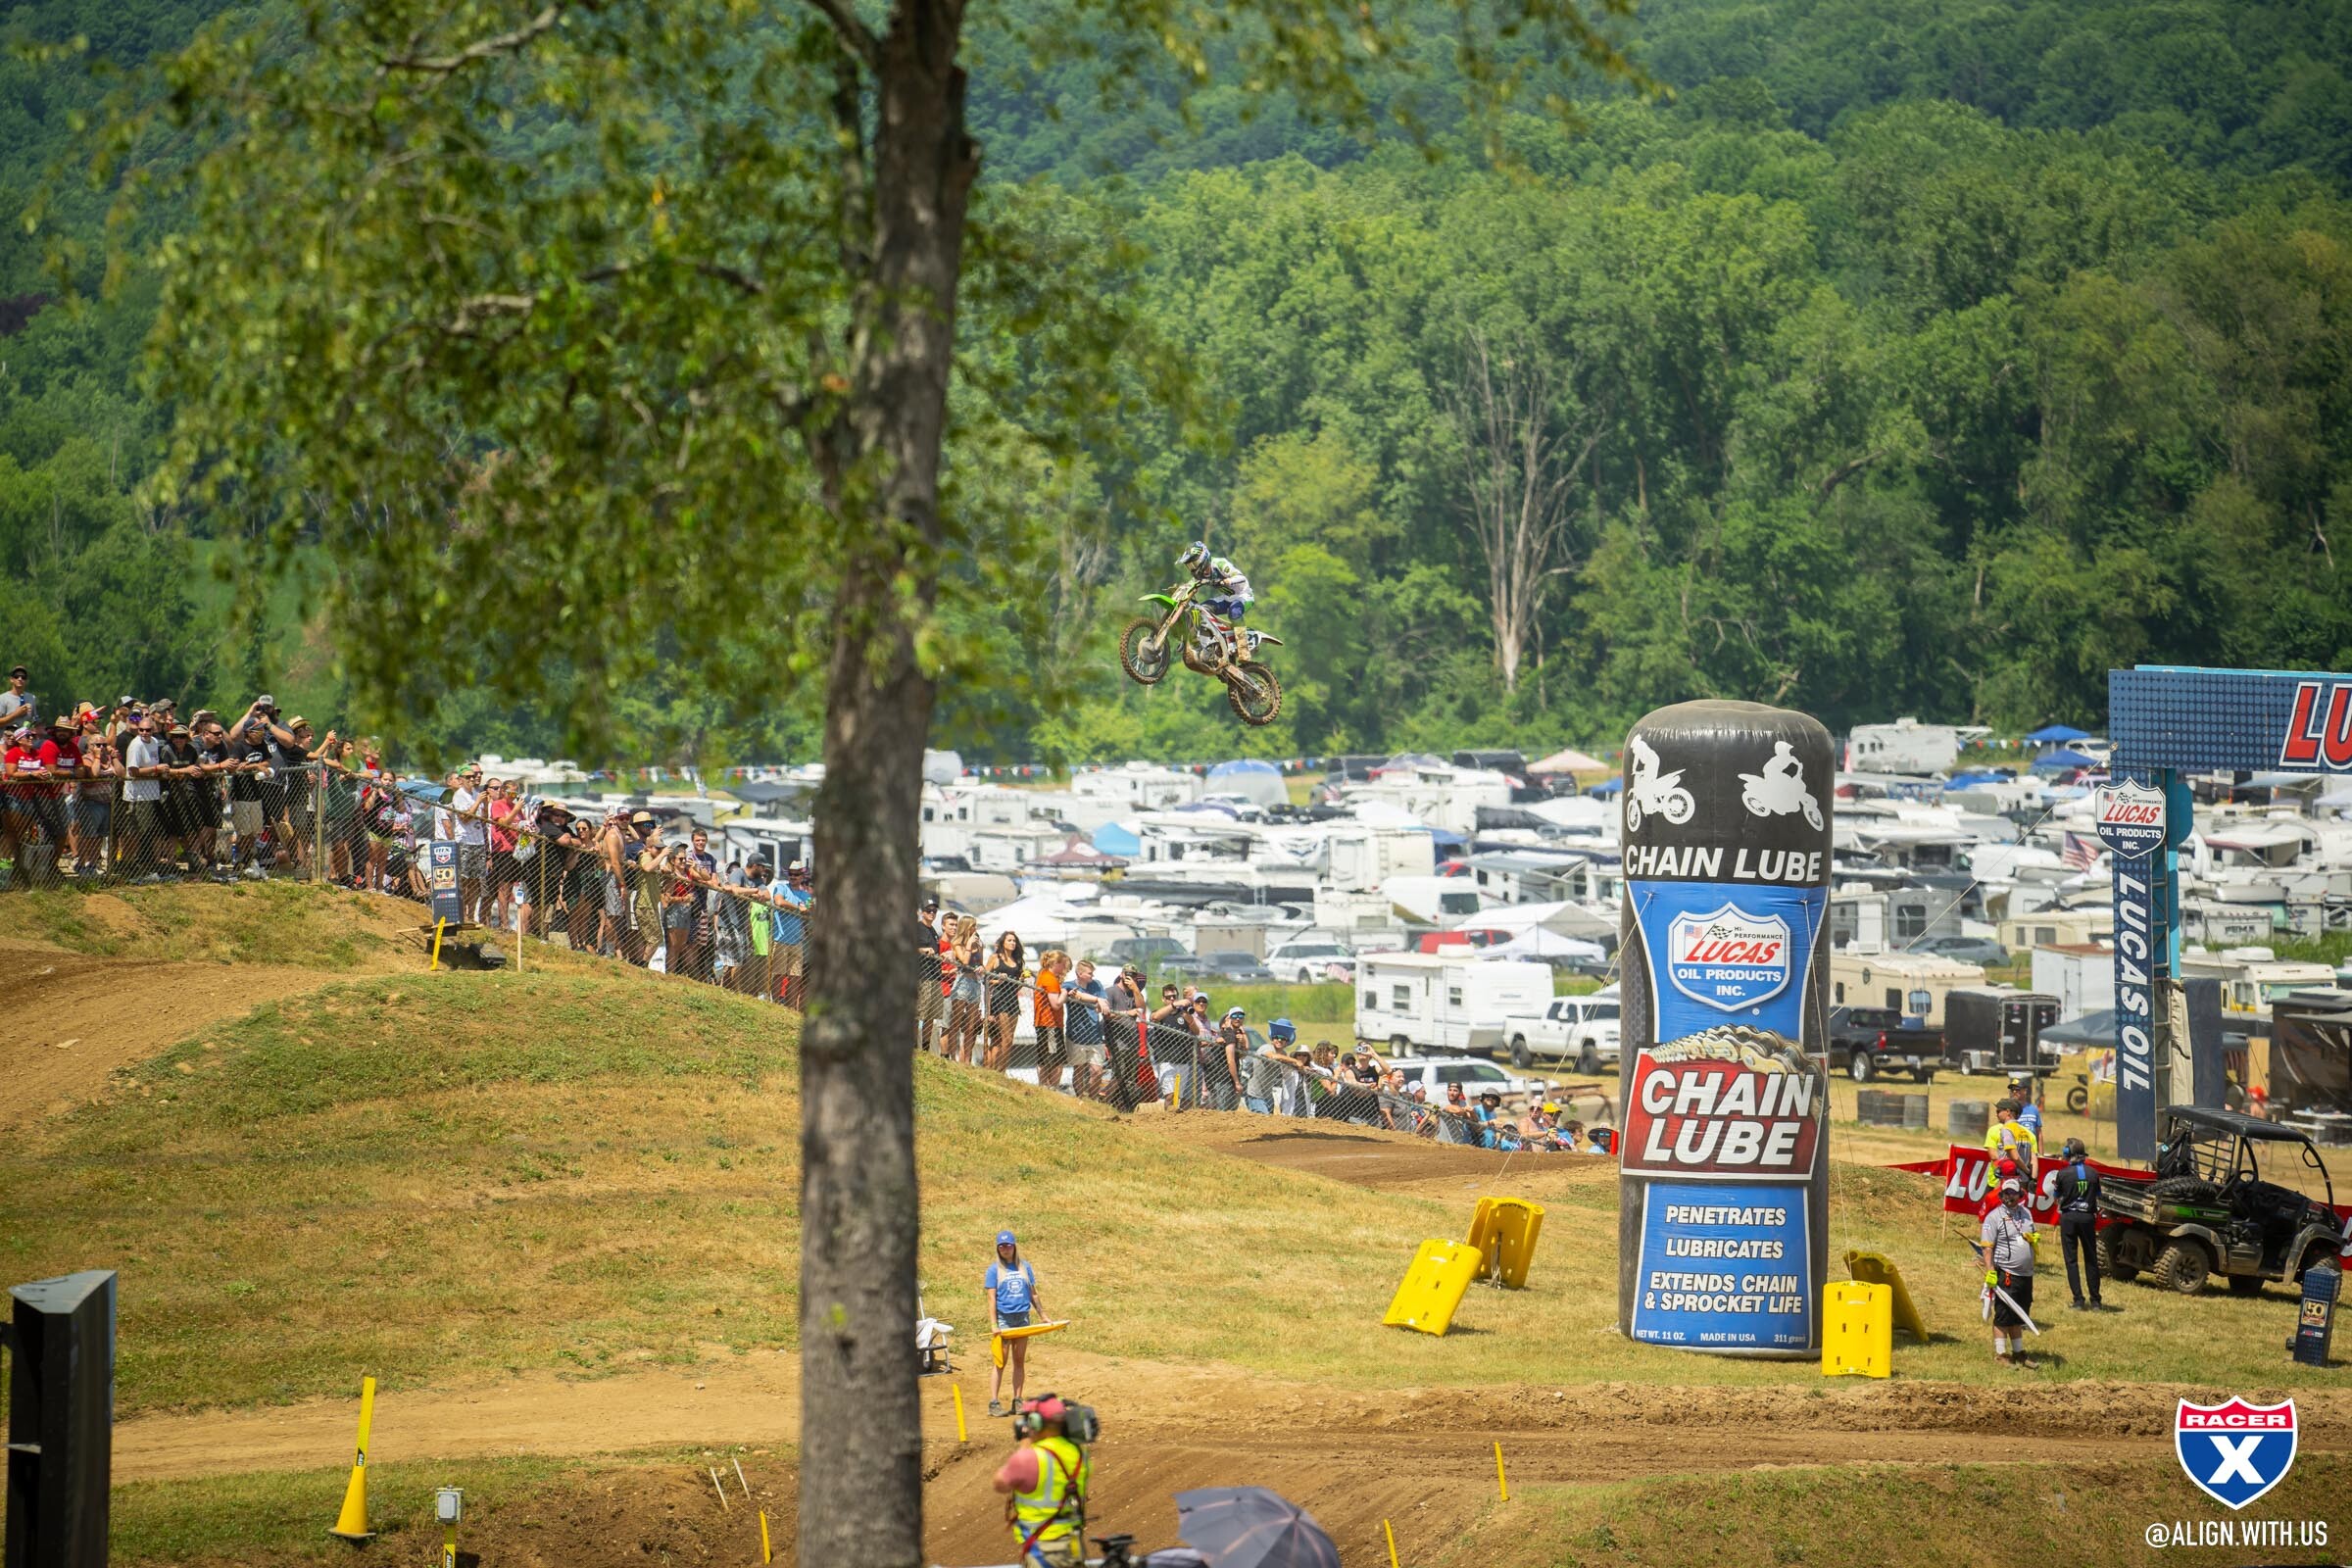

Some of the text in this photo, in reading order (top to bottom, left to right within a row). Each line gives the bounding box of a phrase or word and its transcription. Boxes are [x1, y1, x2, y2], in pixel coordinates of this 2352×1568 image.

[2104, 804, 2161, 824] LUCAS
[2099, 826, 2162, 839] OIL PRODUCTS
[2122, 841, 2140, 850] INC.
[434, 867, 455, 880] 50
[1626, 845, 1823, 882] CHAIN LUBE
[1684, 940, 1782, 964] LUCAS
[1678, 968, 1783, 982] OIL PRODUCTS
[2119, 872, 2150, 1091] LUCAS OIL
[1716, 985, 1746, 997] INC.
[1641, 1069, 1813, 1116] CHAIN
[1642, 1118, 1801, 1166] LUBE
[1945, 1157, 2061, 1211] LUS
[1665, 1205, 1787, 1226] PENETRATES
[1665, 1238, 1785, 1259] LUBRICATES
[1650, 1271, 1798, 1294] EXTENDS CHAIN
[1643, 1291, 1803, 1313] & SPROCKET LIFE
[2304, 1301, 2326, 1317] 50
[1636, 1329, 1647, 1339] NET
[1647, 1330, 1661, 1340] WT.
[1662, 1330, 1672, 1340] 11
[1673, 1332, 1687, 1341] OZ.
[1700, 1333, 1726, 1342] MADE
[1728, 1333, 1738, 1342] IN
[1739, 1333, 1756, 1342] USA
[1774, 1334, 1788, 1343] 311
